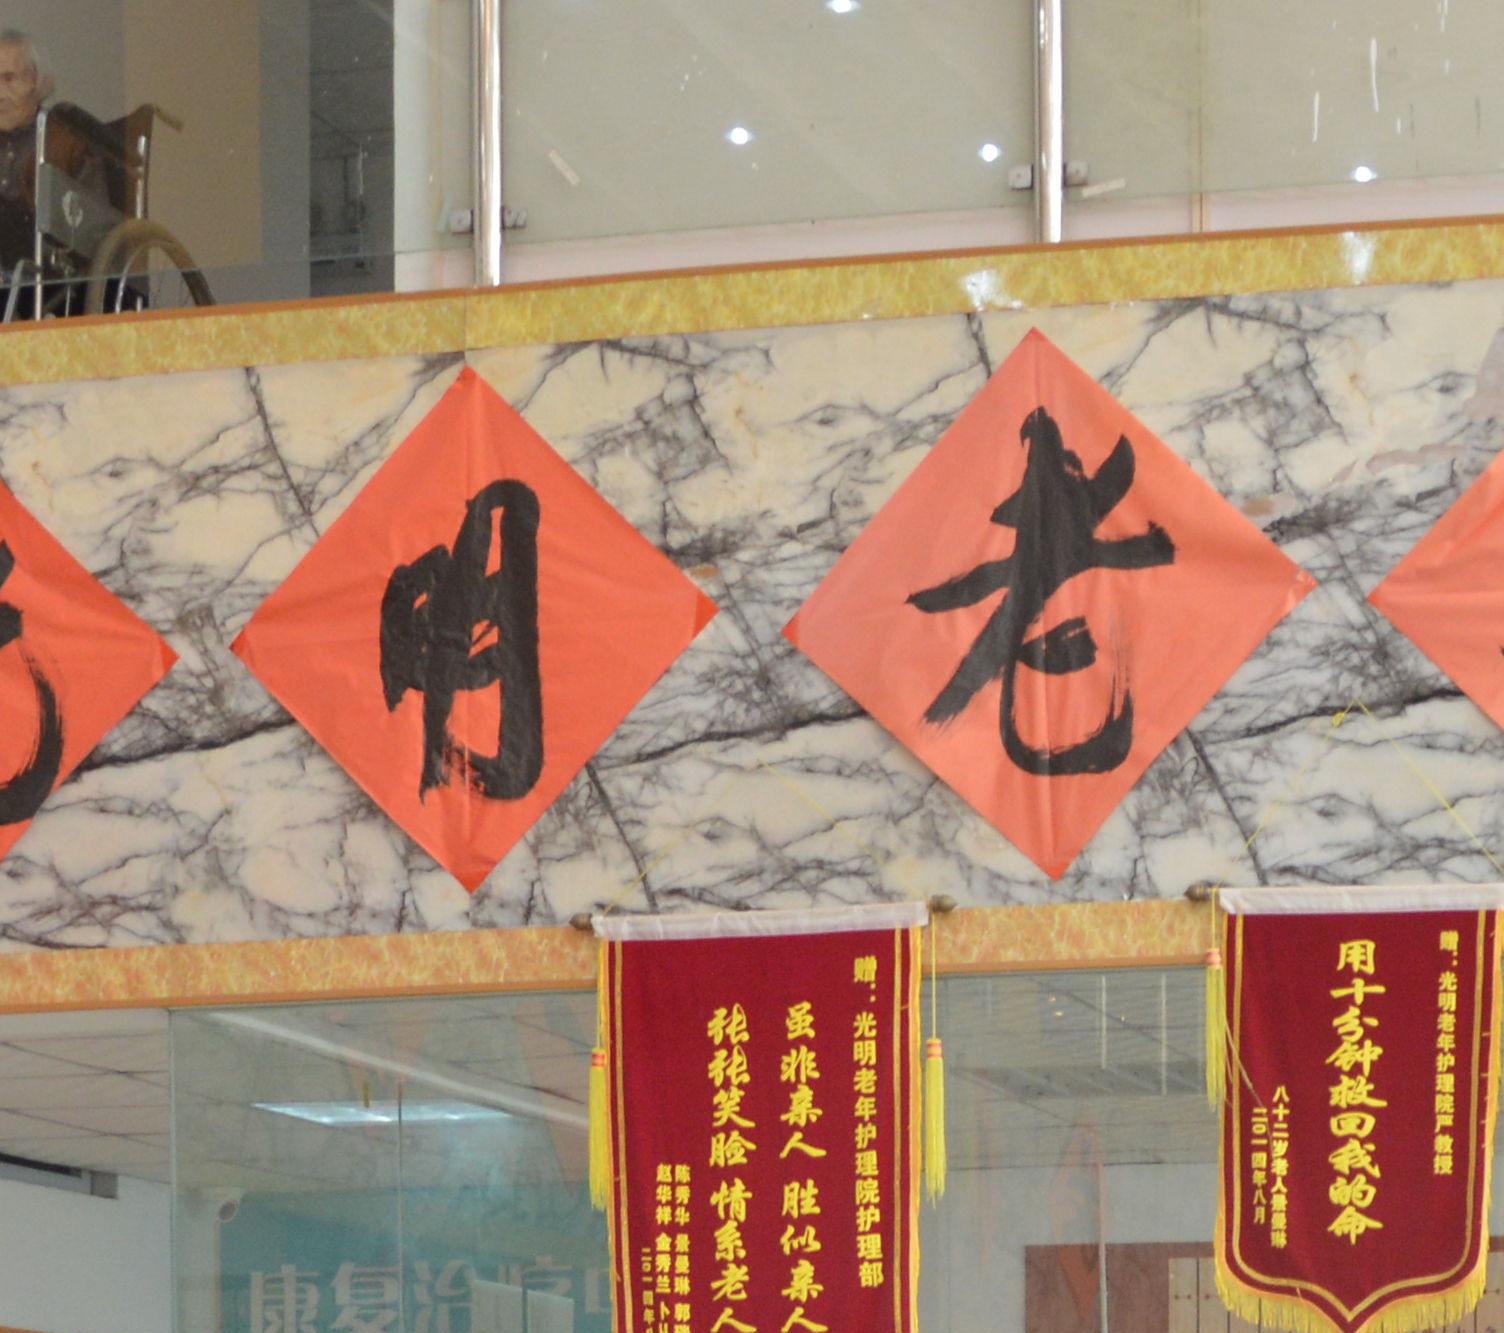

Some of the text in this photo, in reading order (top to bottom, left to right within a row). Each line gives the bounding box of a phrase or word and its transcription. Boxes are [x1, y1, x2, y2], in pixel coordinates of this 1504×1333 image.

[706, 1001, 758, 1169] 张张笑脸
[778, 1000, 830, 1160] 虽非亲人
[1324, 938, 1389, 1247] 用十分钟救回我的命
